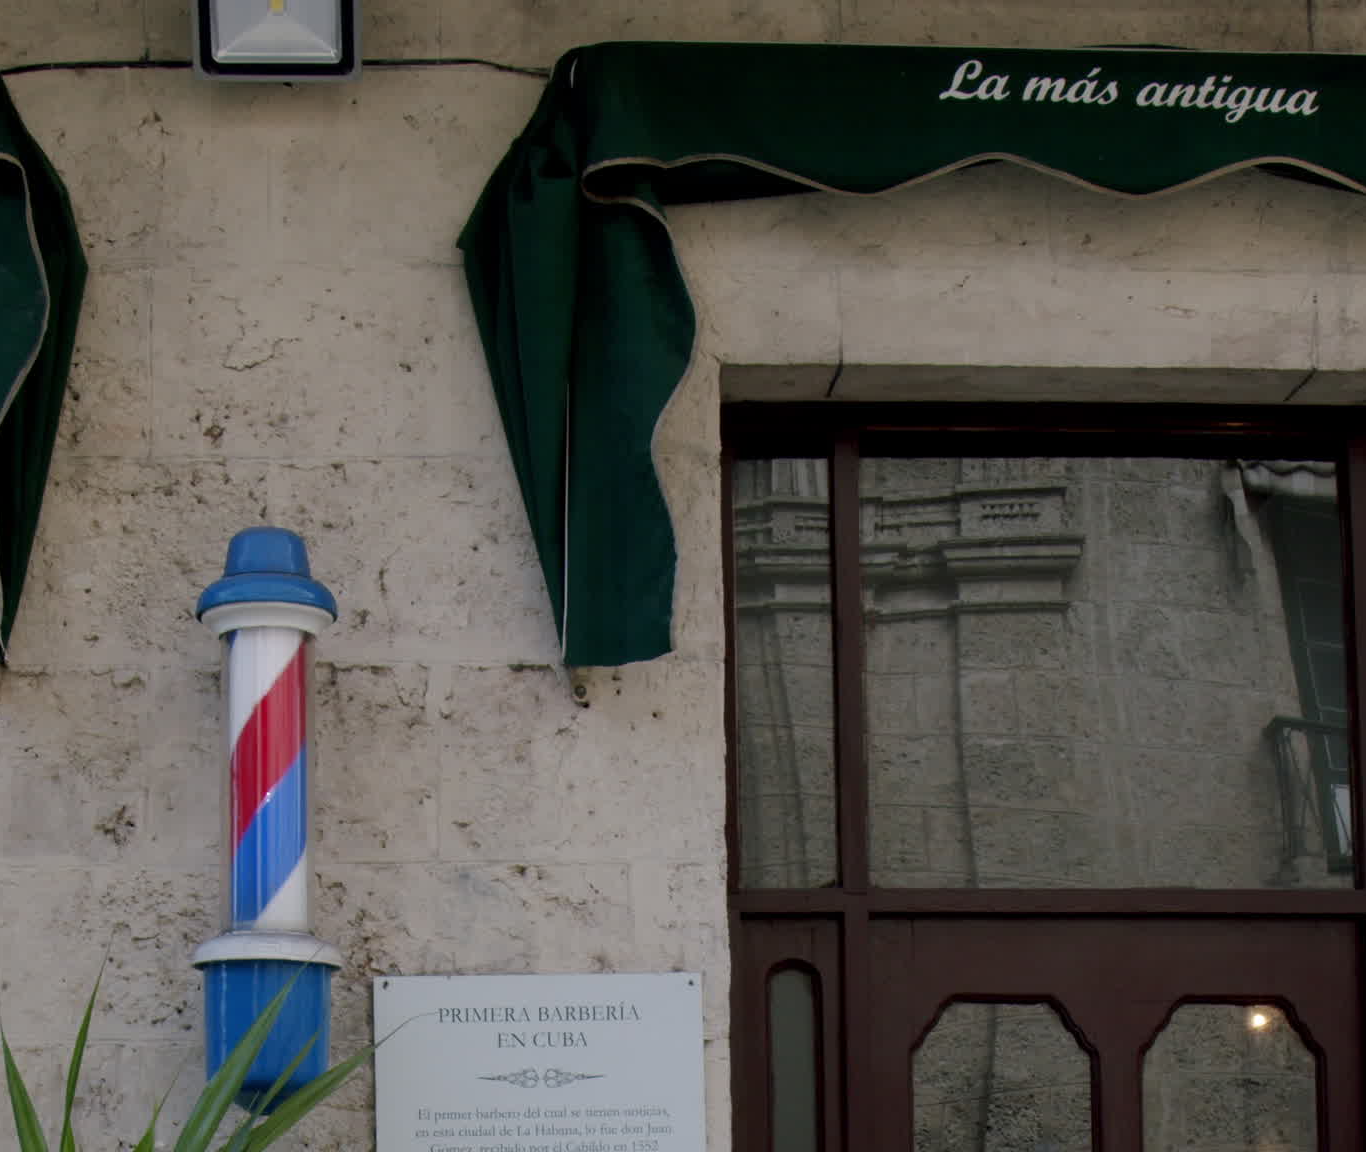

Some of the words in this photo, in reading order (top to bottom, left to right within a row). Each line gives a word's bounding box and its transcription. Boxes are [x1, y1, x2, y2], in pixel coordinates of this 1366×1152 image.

[939, 60, 1010, 100] La
[1022, 67, 1119, 104] más
[1136, 75, 1319, 124] antigua
[438, 1007, 531, 1024] PRIMERA
[538, 1001, 641, 1023] BARBERÍA
[498, 1032, 526, 1049] EN
[532, 1031, 588, 1048] CUBA
[418, 1108, 430, 1121] El
[434, 1110, 472, 1125] primer
[475, 1107, 521, 1121] barbero
[523, 1106, 541, 1119] del
[544, 1106, 567, 1118] cual
[570, 1110, 580, 1118] se
[586, 1107, 620, 1118] tienen
[415, 1129, 429, 1138] en
[432, 1127, 455, 1138] esta
[458, 1124, 496, 1137] ciudad
[499, 1124, 514, 1137] de
[517, 1125, 531, 1137] La
[535, 1123, 582, 1137] Habana,
[586, 1123, 596, 1135] lo
[600, 1123, 618, 1135] fue
[621, 1122, 643, 1135] don
[645, 1122, 672, 1137] Juan
[565, 1139, 611, 1152] Cabildo
[614, 1143, 628, 1152] en
